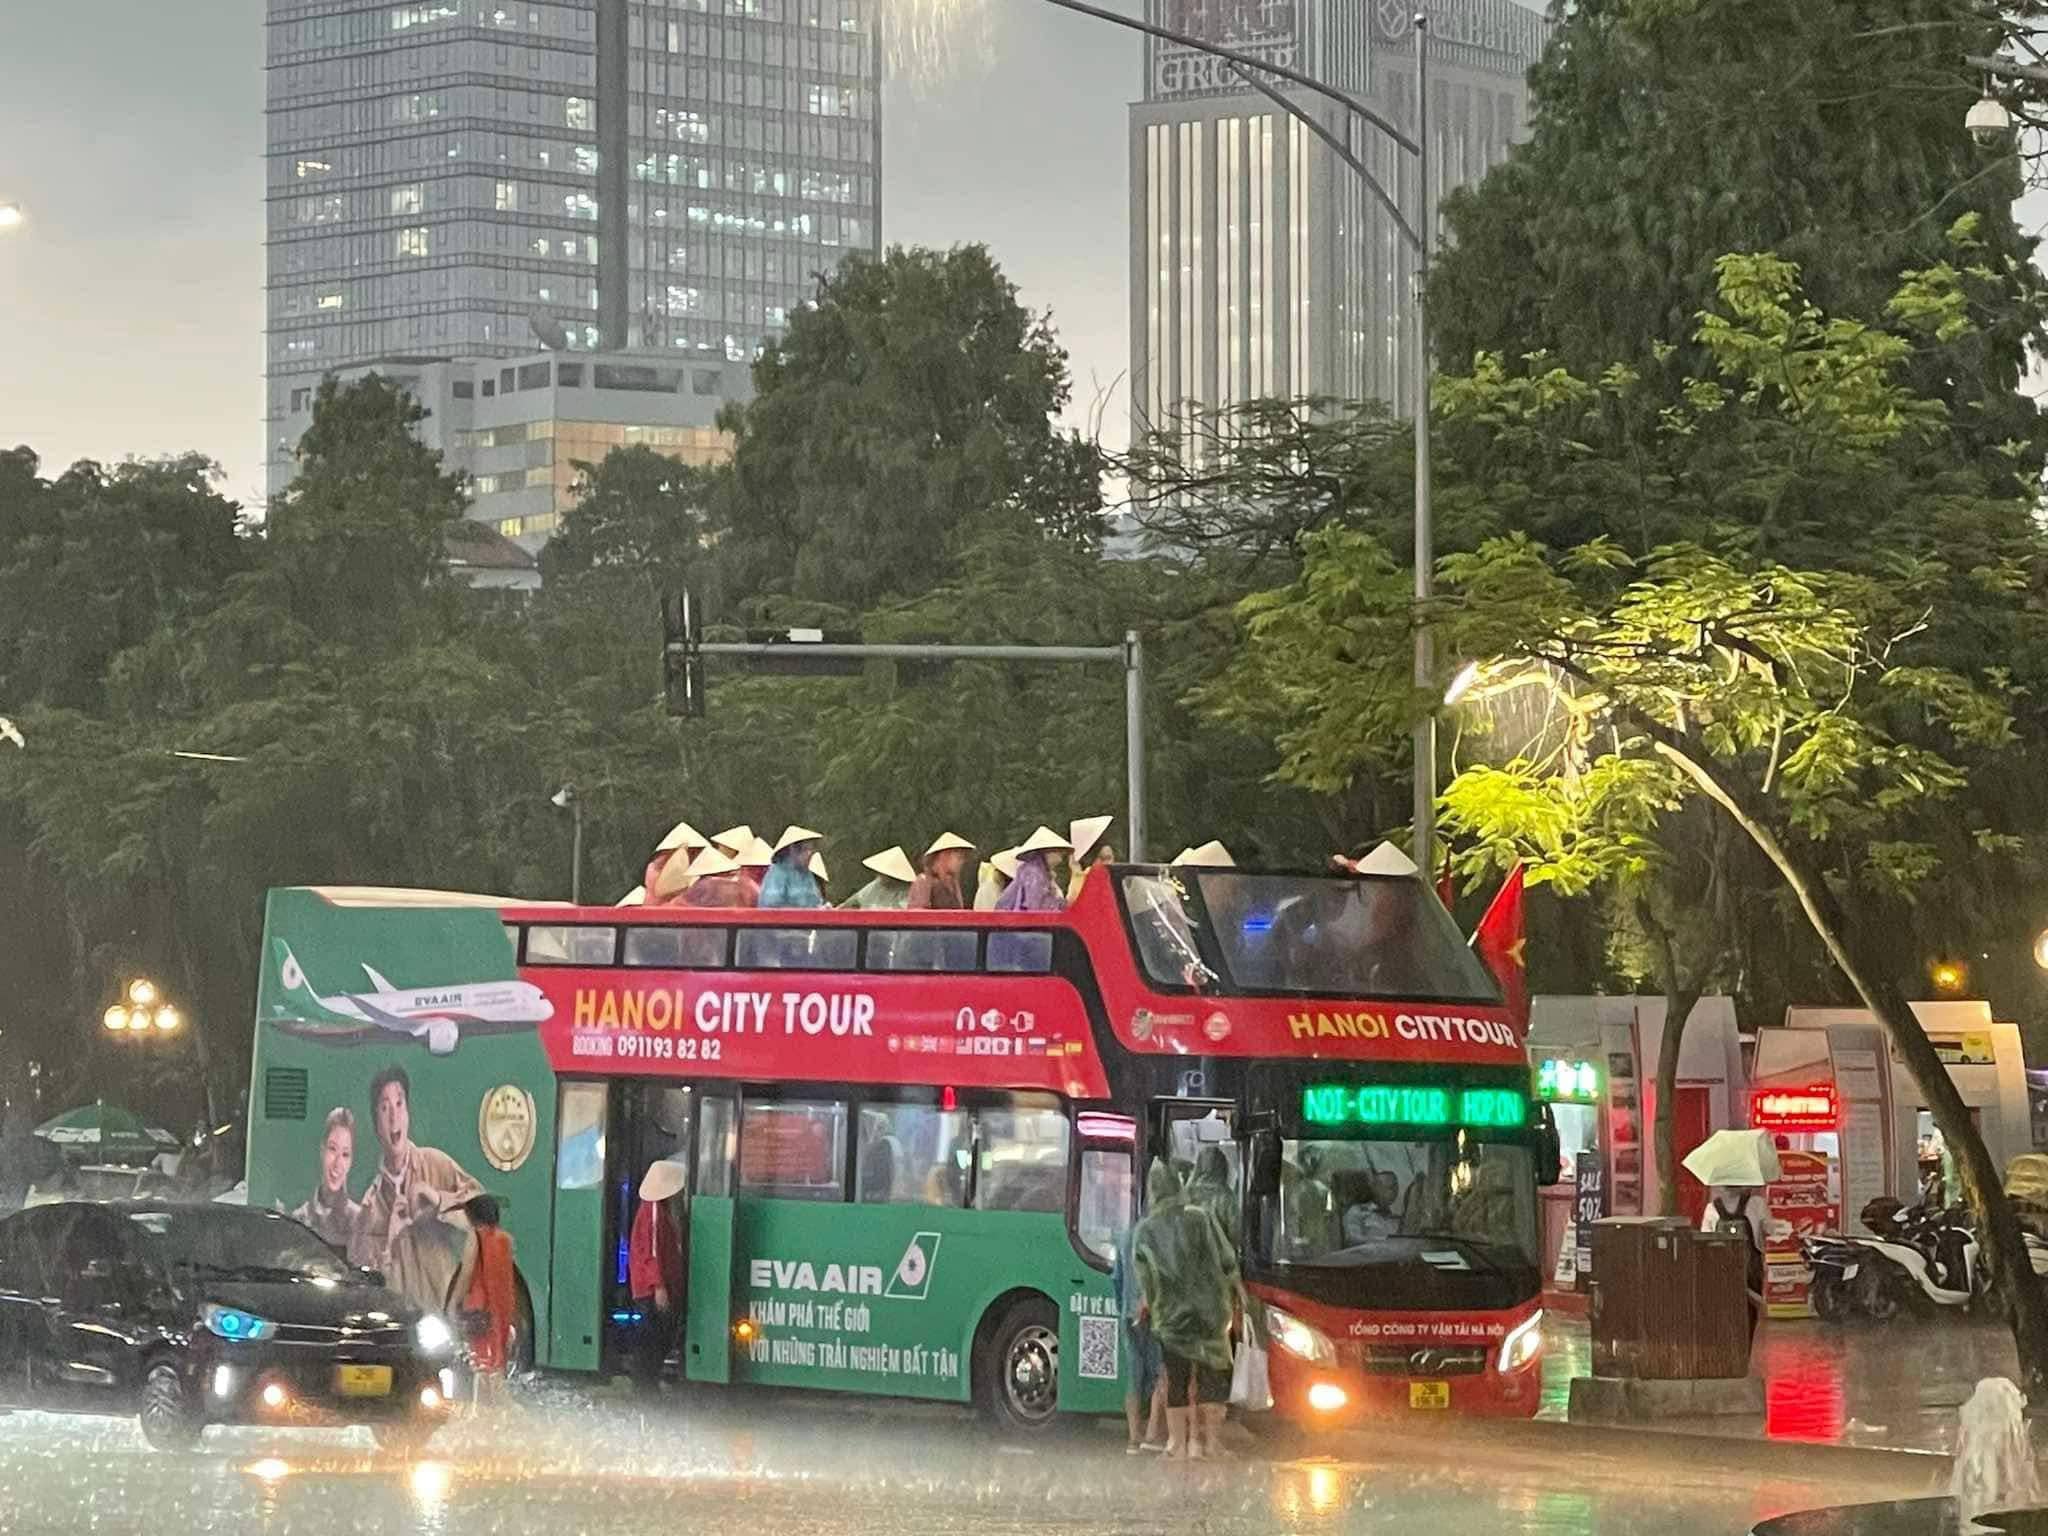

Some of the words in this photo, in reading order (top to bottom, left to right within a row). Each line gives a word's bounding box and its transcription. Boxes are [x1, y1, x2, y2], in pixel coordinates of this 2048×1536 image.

[574, 989, 684, 1030] HANOI
[695, 991, 772, 1033] CITY
[782, 992, 875, 1036] TOUR
[1287, 1013, 1390, 1039] HANOI
[617, 1035, 673, 1059] 091193
[677, 1038, 697, 1060] 82
[701, 1039, 721, 1061] 82
[788, 1299, 814, 1329] PHÁ
